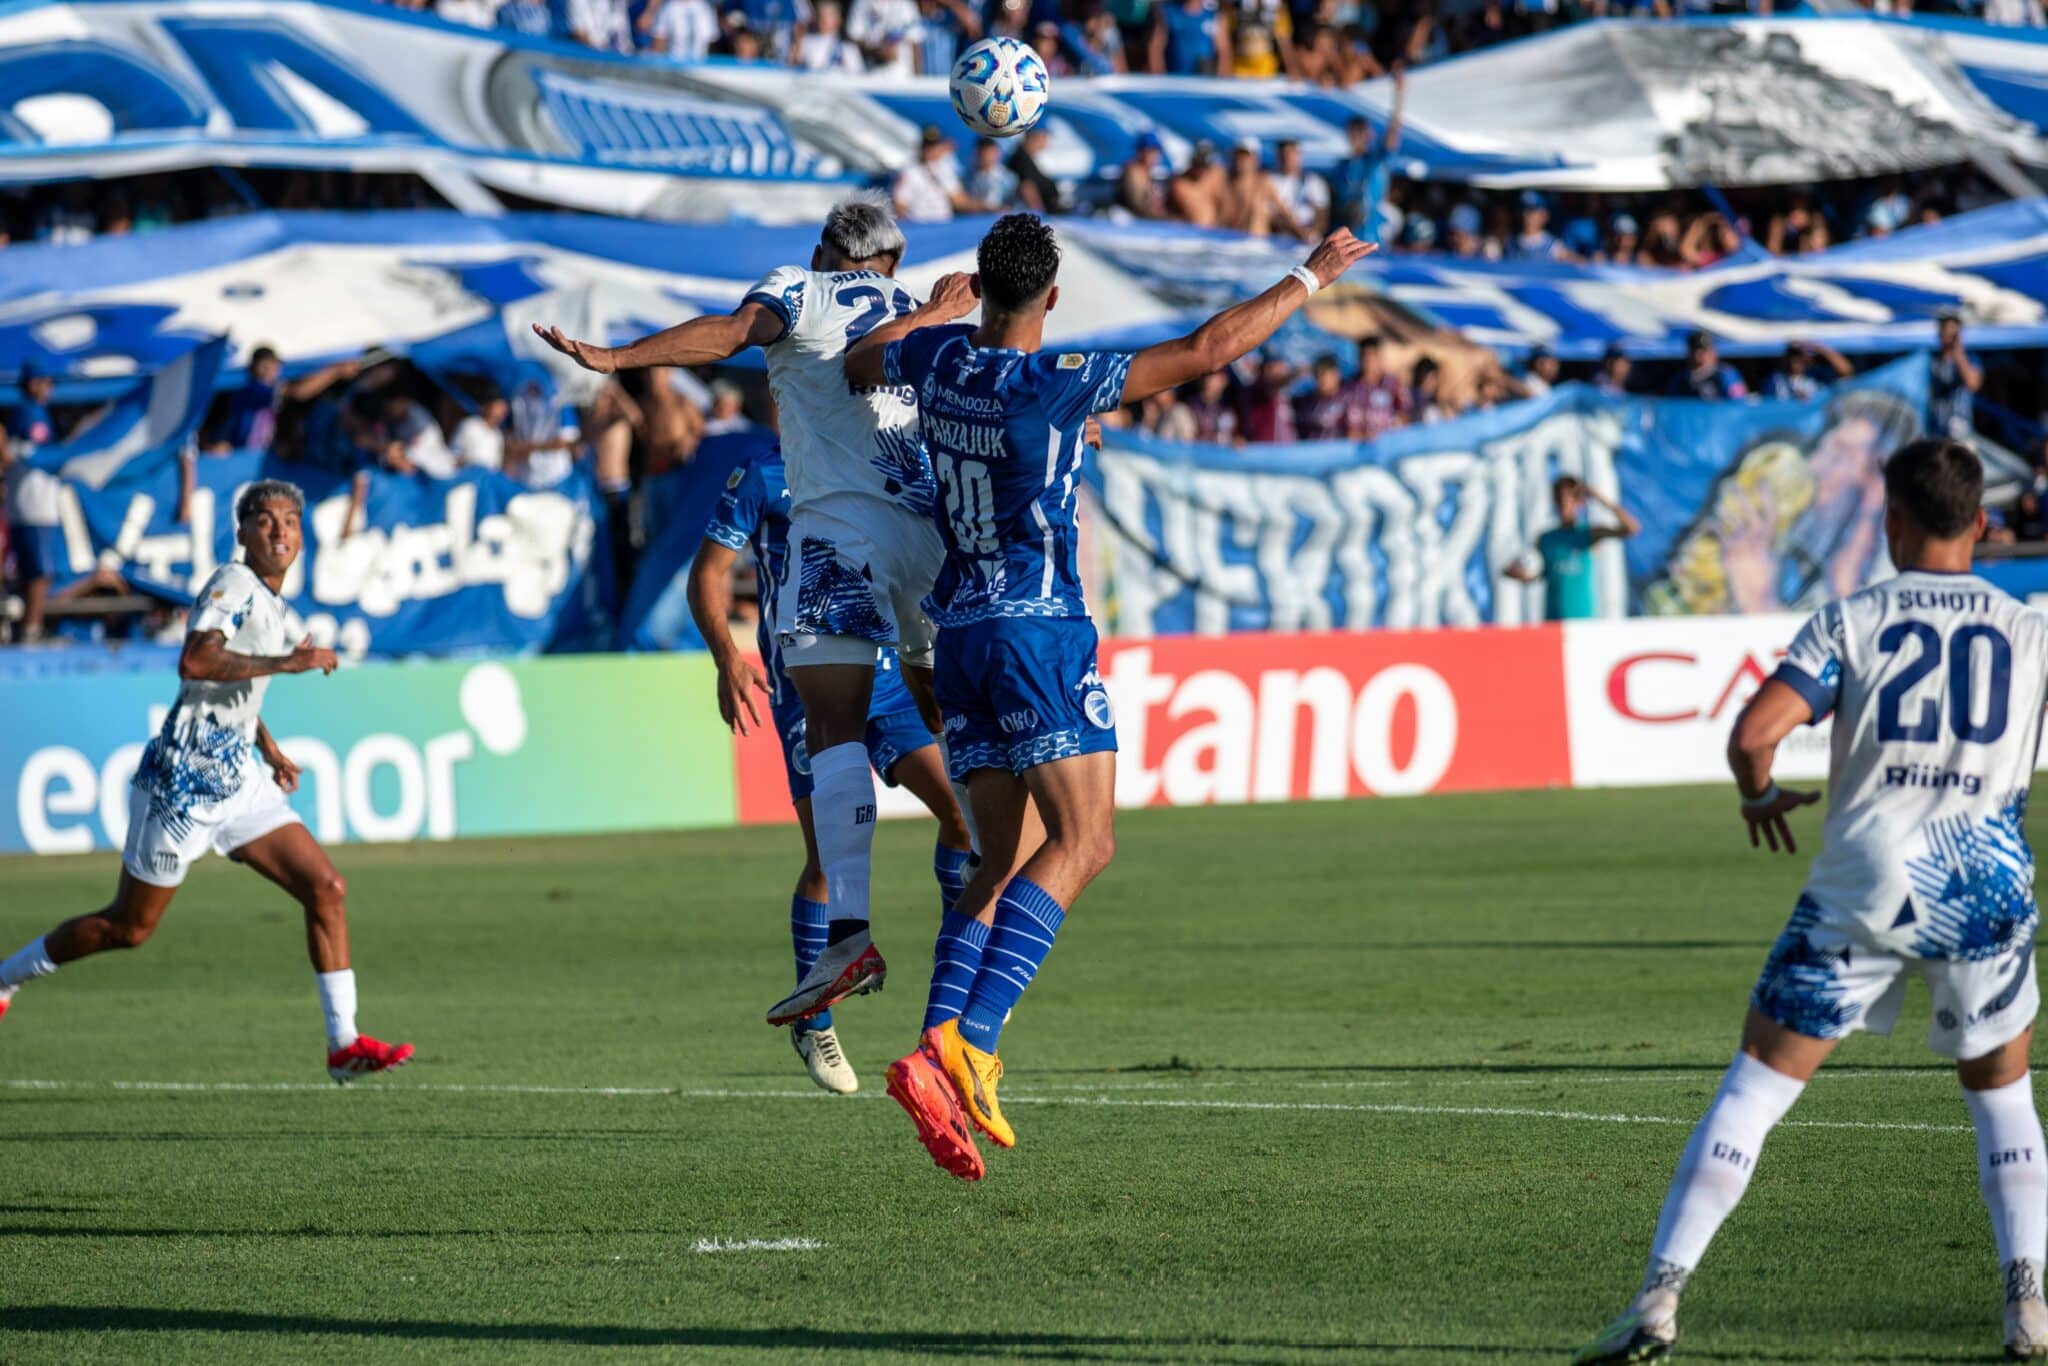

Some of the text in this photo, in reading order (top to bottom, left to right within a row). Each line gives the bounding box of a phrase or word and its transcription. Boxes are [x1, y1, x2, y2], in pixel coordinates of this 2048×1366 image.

[938, 384, 1003, 413] MENDOZA
[1897, 591, 1991, 613] SCHOTT
[1878, 620, 2011, 745] 20
[1886, 763, 1981, 795] Riiing
